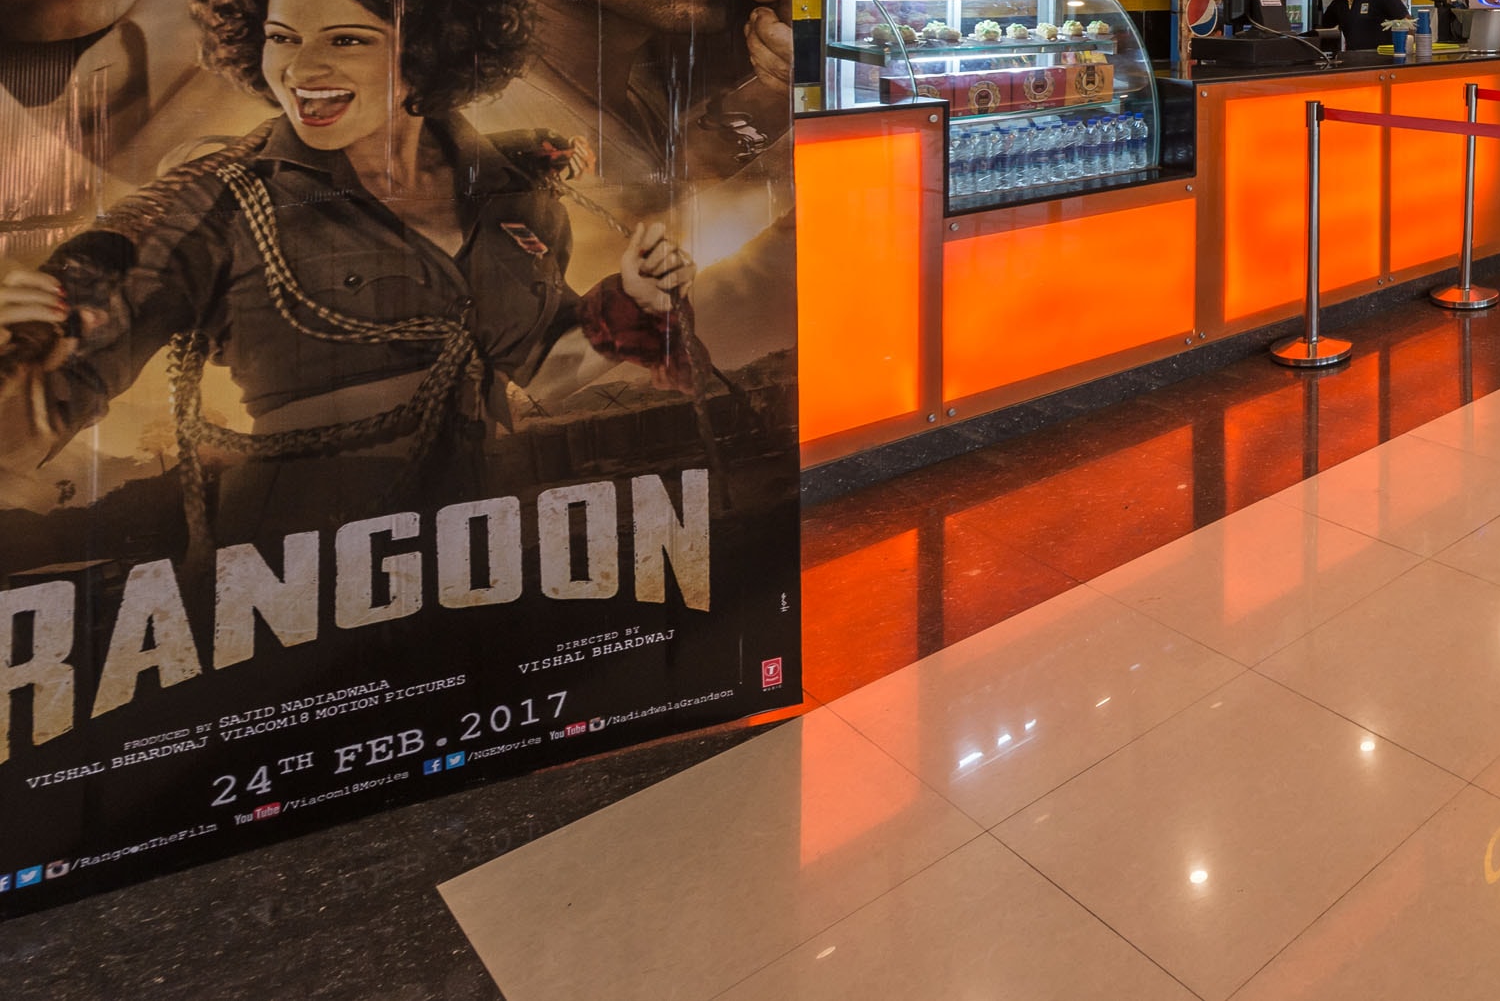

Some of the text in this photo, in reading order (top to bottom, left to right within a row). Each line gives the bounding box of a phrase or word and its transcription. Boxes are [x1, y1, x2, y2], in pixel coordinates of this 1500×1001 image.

[0, 469, 711, 766] RANGOON
[556, 625, 640, 652] DIRECTED BY
[518, 629, 675, 674] VISHAL BHARDWAJ
[26, 674, 467, 789] VISHAL BHARDWAJ VIACOM18 MOTION PICTURES
[123, 679, 390, 751] PRODUCED BY SAJID NADIADWALA
[606, 689, 735, 726] /NadiadwalaGrandson
